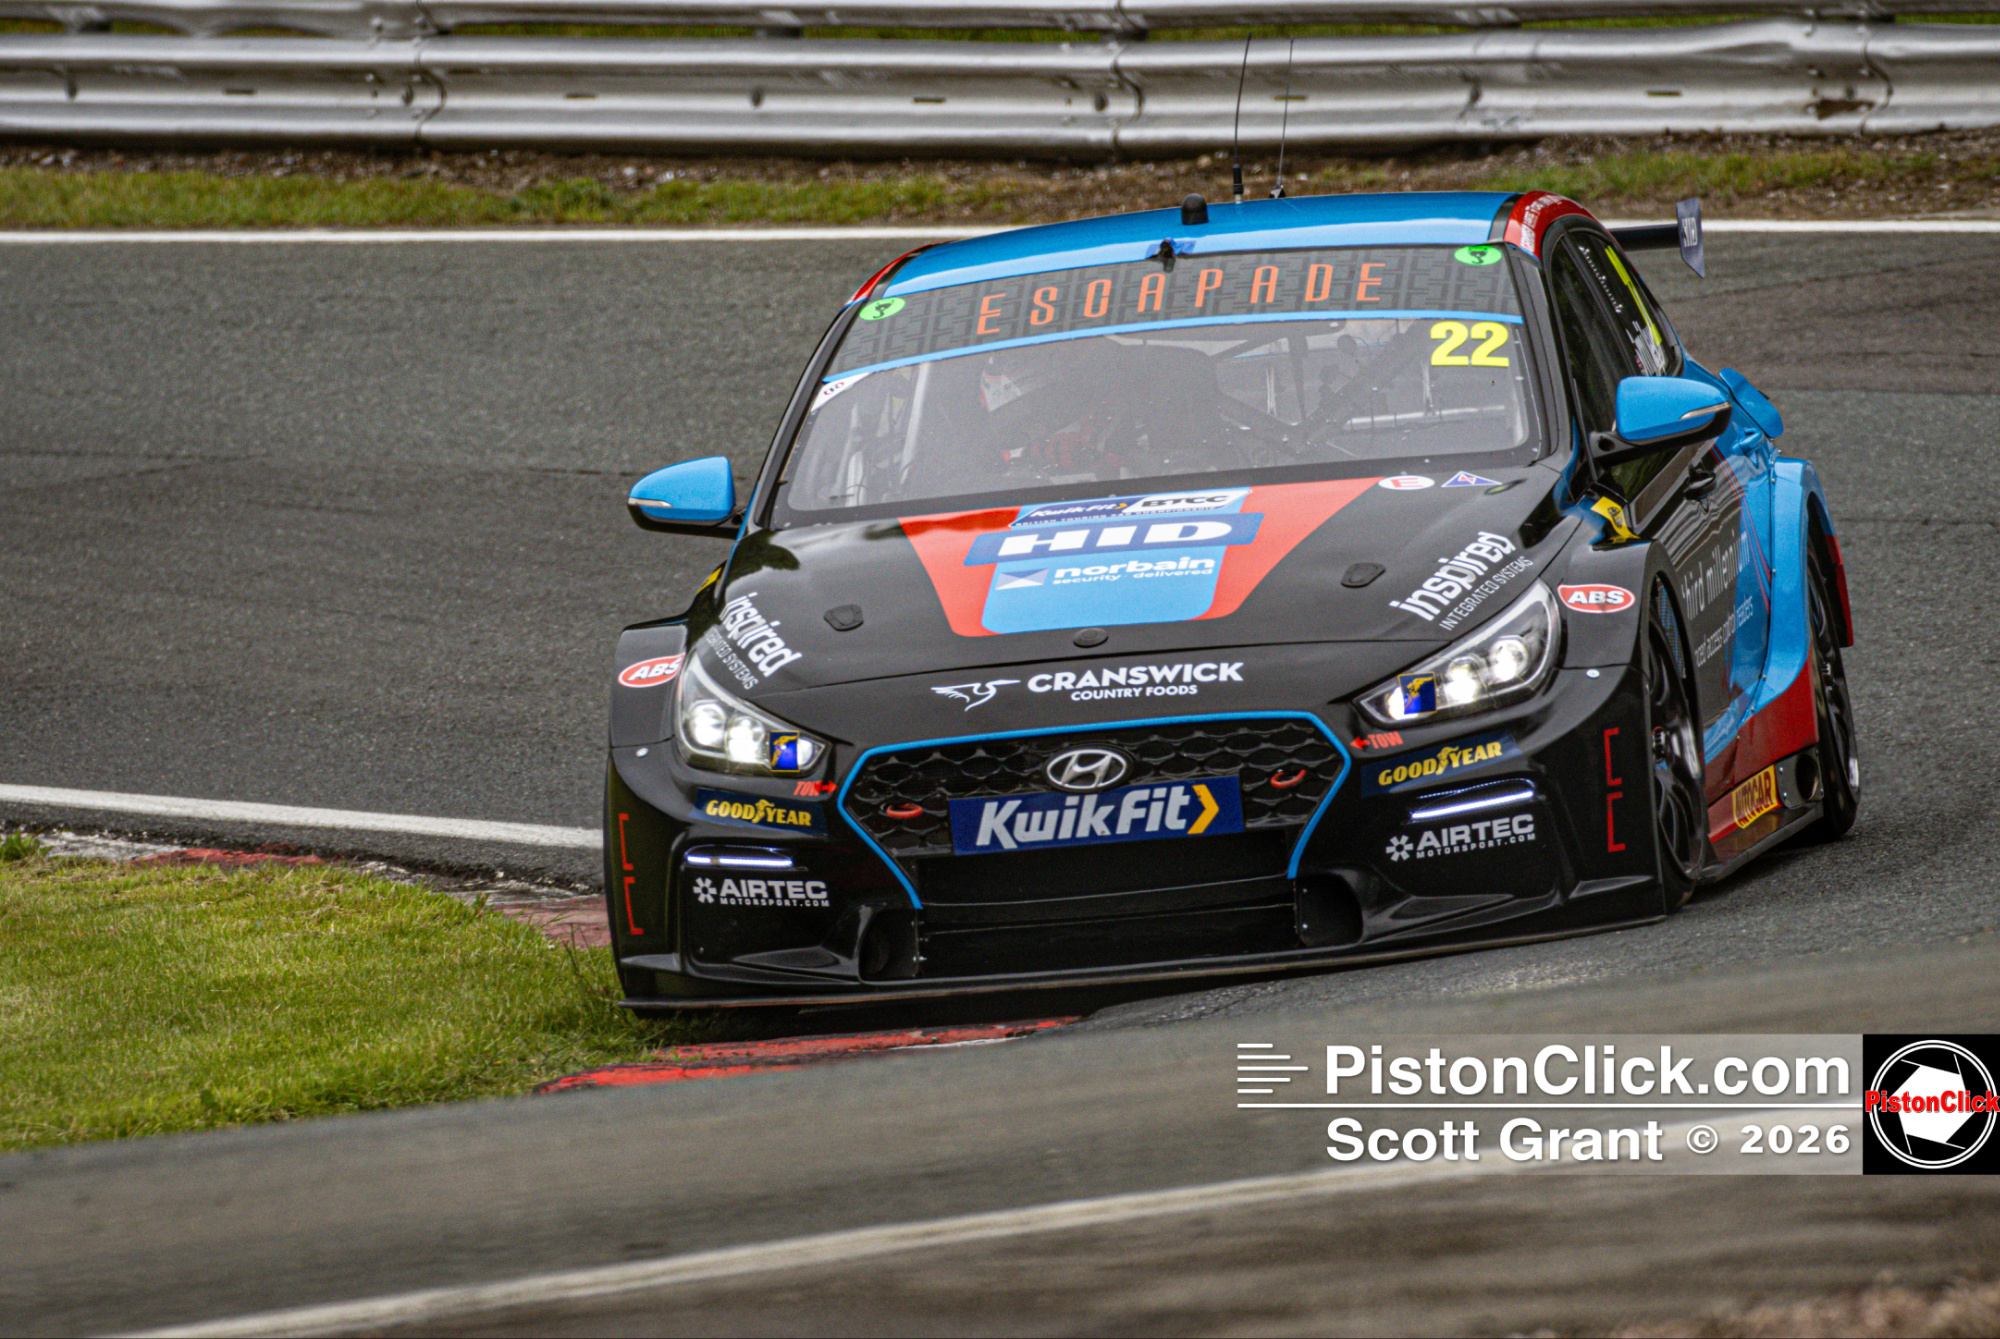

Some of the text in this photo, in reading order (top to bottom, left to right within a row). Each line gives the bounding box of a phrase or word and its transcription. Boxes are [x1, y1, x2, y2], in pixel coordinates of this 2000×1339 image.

[976, 263, 1386, 335] ESCAPADE
[1430, 320, 1510, 367] 22
[1141, 495, 1229, 507] BTCC
[998, 521, 1232, 556] HID
[1053, 568, 1213, 585] security delivered
[1054, 556, 1216, 579] norbain
[1389, 531, 1517, 621] inspired
[1439, 555, 1533, 631] INTEGRATED SYSTEMS
[1567, 588, 1626, 607] ABS
[718, 591, 803, 678] inspired
[628, 656, 681, 682] ABS
[722, 650, 759, 690] SYSTEMS
[1027, 662, 1244, 693] CRANSWICK
[1070, 684, 1198, 702] COUNTRY FOODS
[1367, 731, 1404, 749] TOW
[793, 780, 823, 797] TOW
[1416, 814, 1535, 851] AIRTEC
[1416, 832, 1536, 859] MOTORSPORT.COM
[719, 878, 828, 899] AIRTEC
[720, 898, 830, 907] MOTORSPORT.COM
